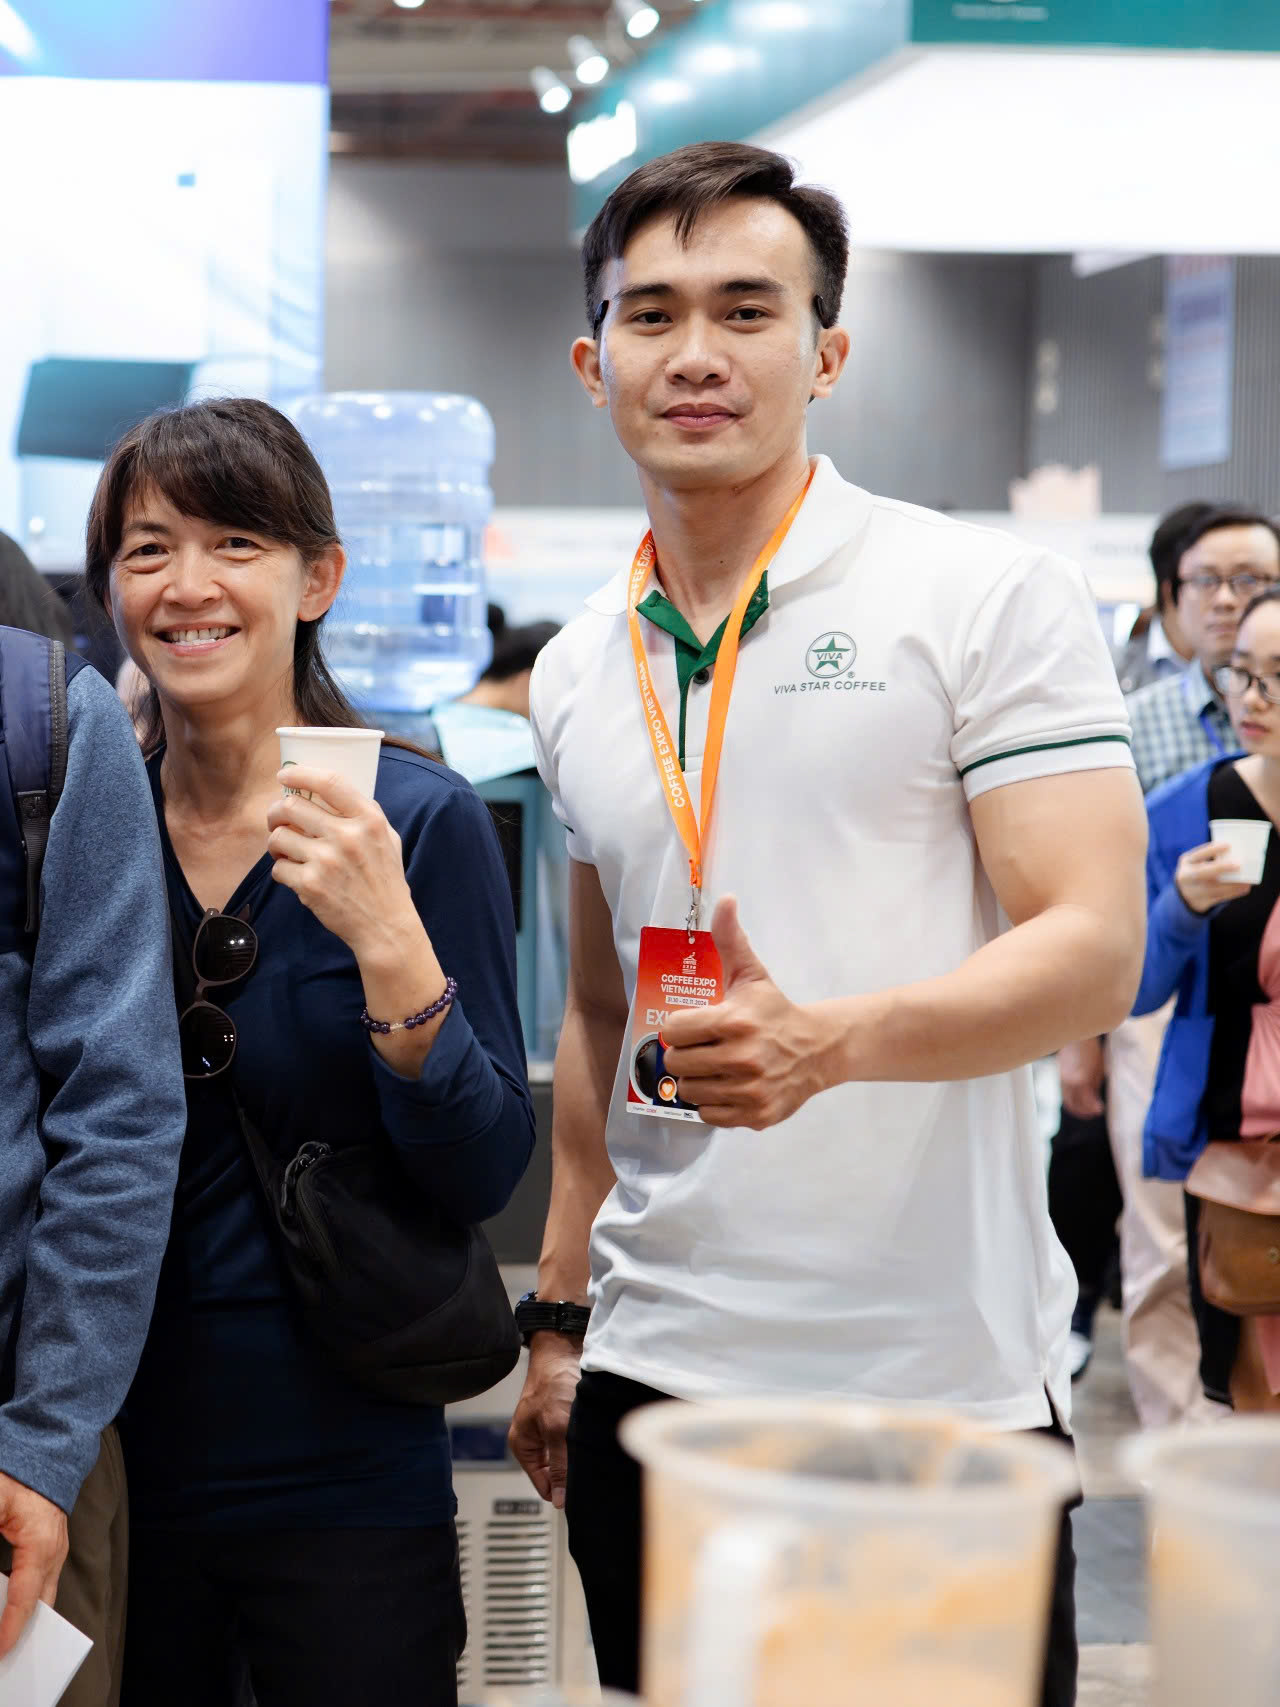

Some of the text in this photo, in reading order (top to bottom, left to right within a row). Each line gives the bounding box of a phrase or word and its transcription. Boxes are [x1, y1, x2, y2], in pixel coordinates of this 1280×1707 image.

[816, 652, 843, 661] VIVA
[774, 681, 887, 695] VIVA STAR COFFEE
[638, 661, 685, 808] COFFEE EXPO VIETNAM
[661, 973, 717, 988] COFFEE EXPO
[660, 983, 716, 997] VIETNAM 2024
